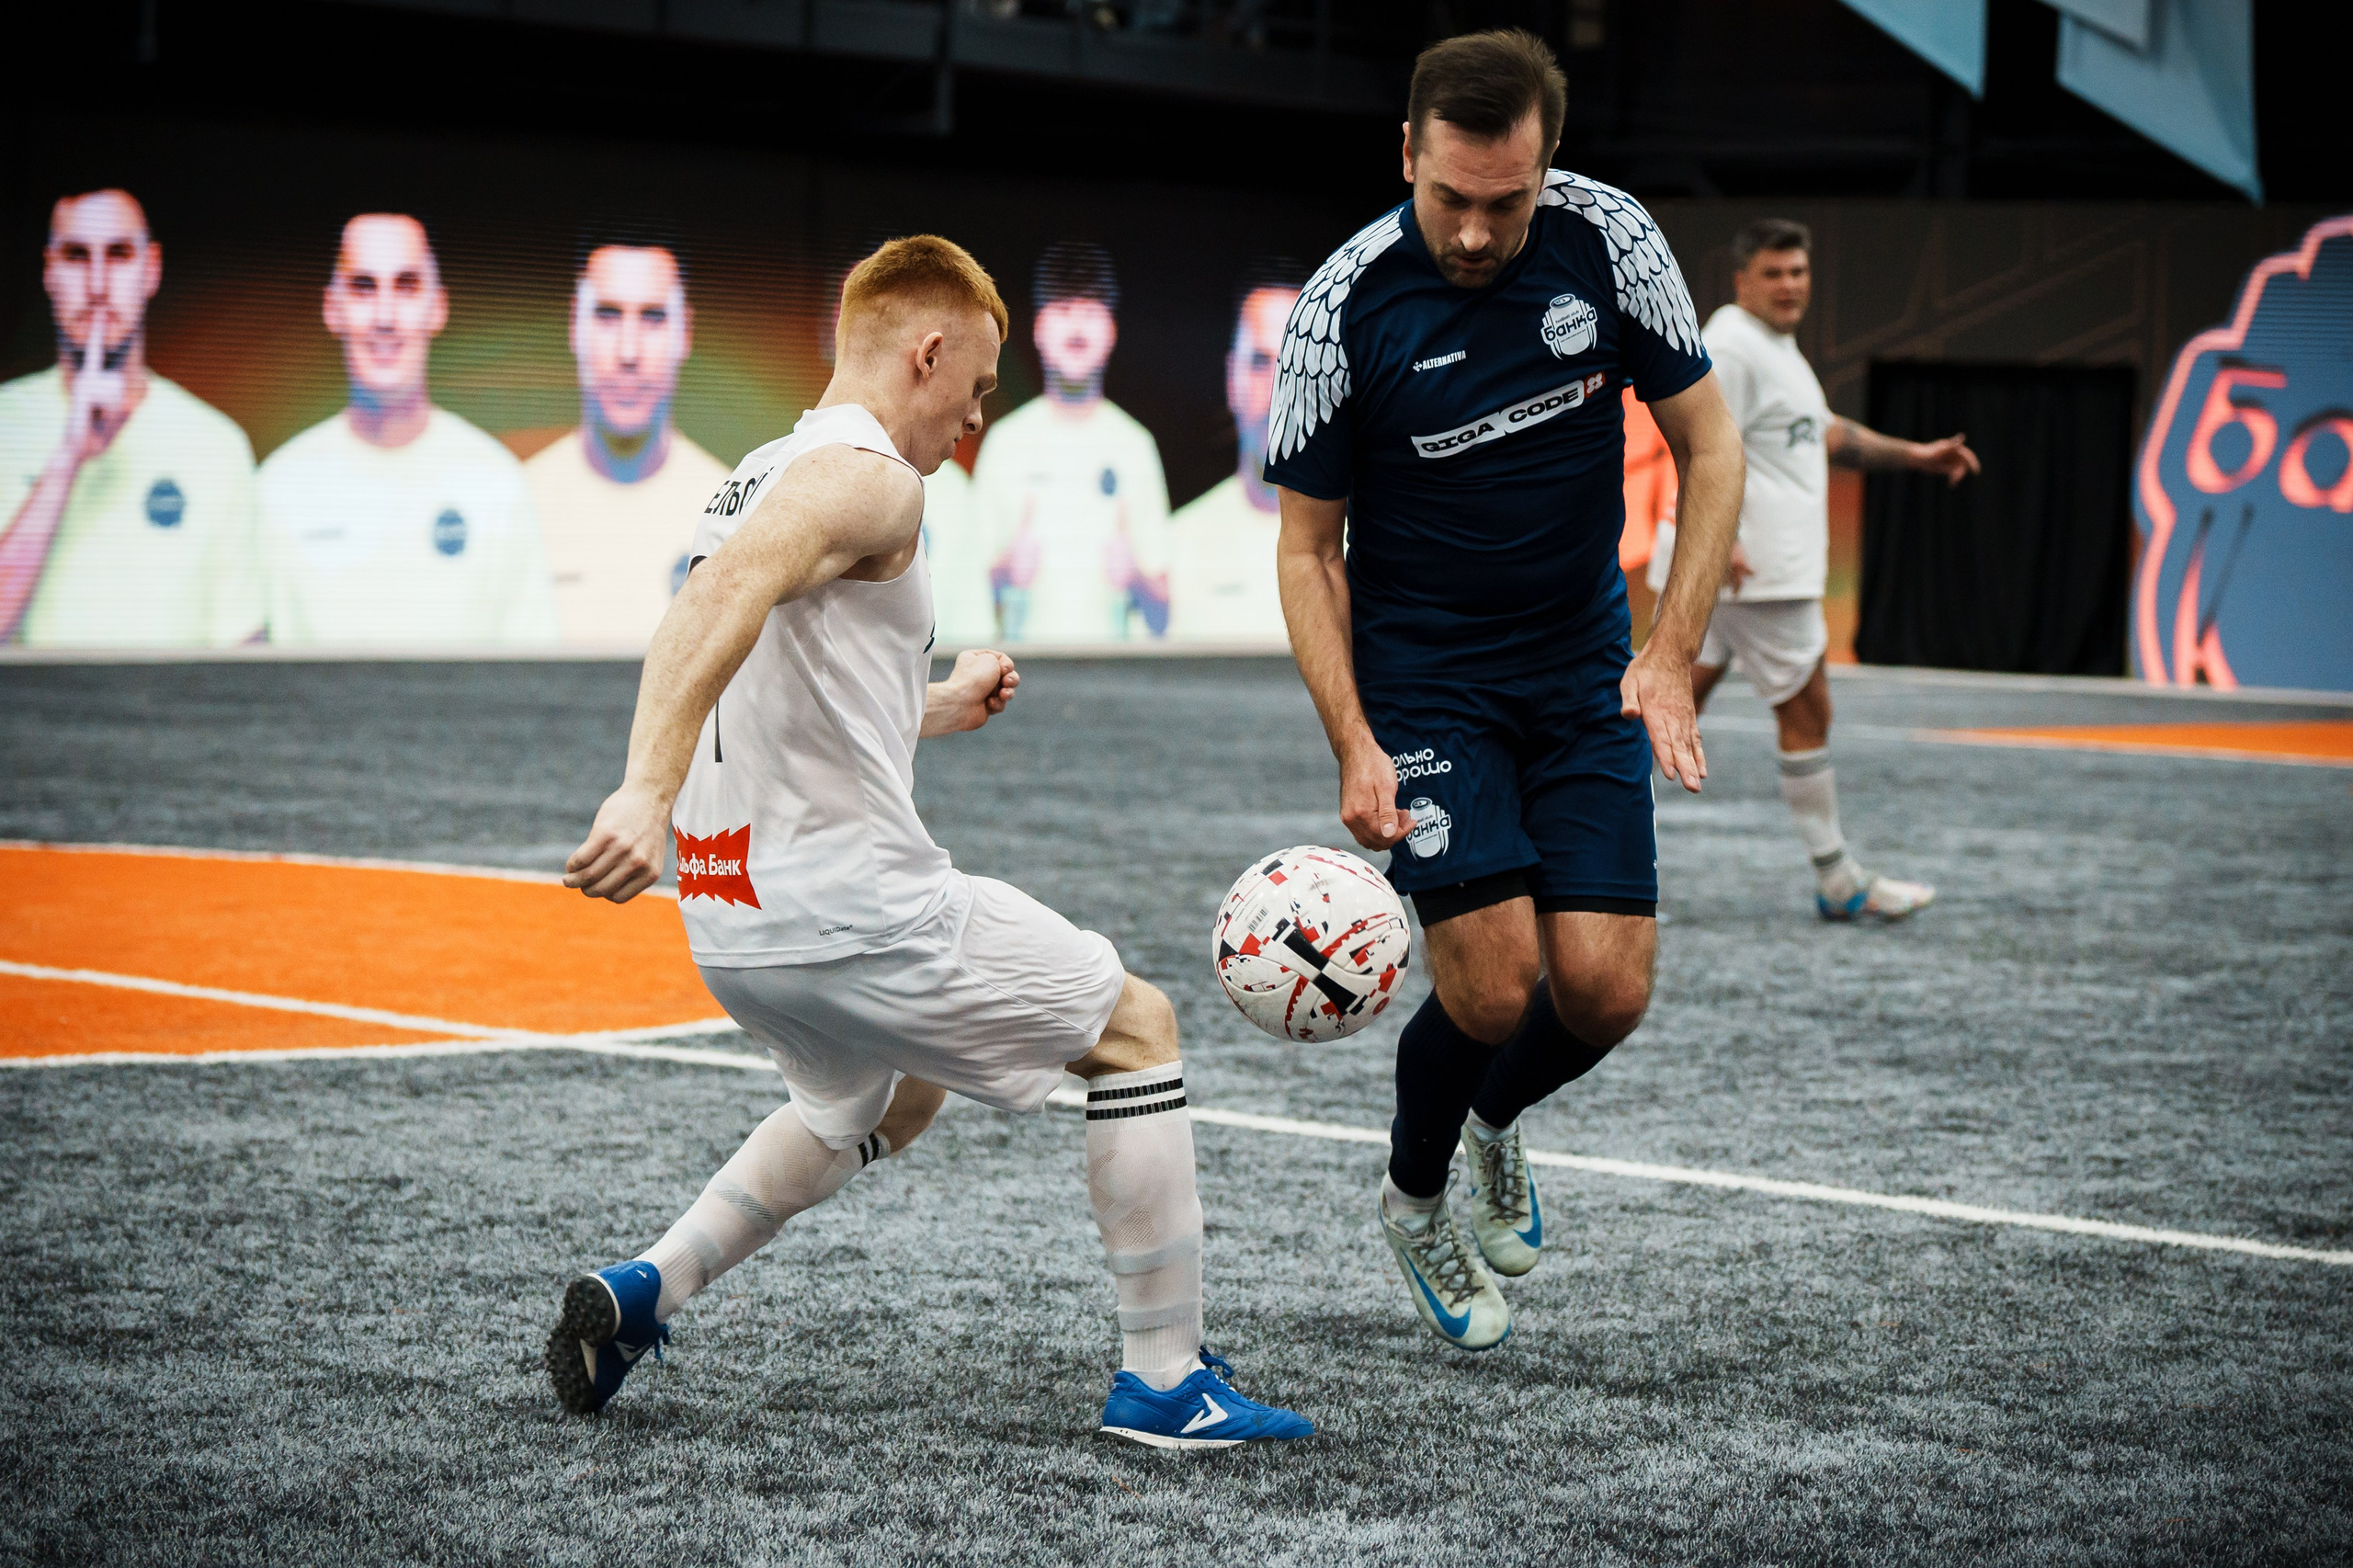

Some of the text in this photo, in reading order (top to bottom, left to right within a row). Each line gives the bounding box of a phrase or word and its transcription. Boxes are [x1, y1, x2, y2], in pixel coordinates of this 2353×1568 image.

[1422, 350, 1466, 370] ALTERNATIVA
[1508, 388, 1579, 423] CODE
[1392, 748, 1435, 768] ольно
[1395, 760, 1452, 786] орошо
[709, 853, 742, 876] Банк
